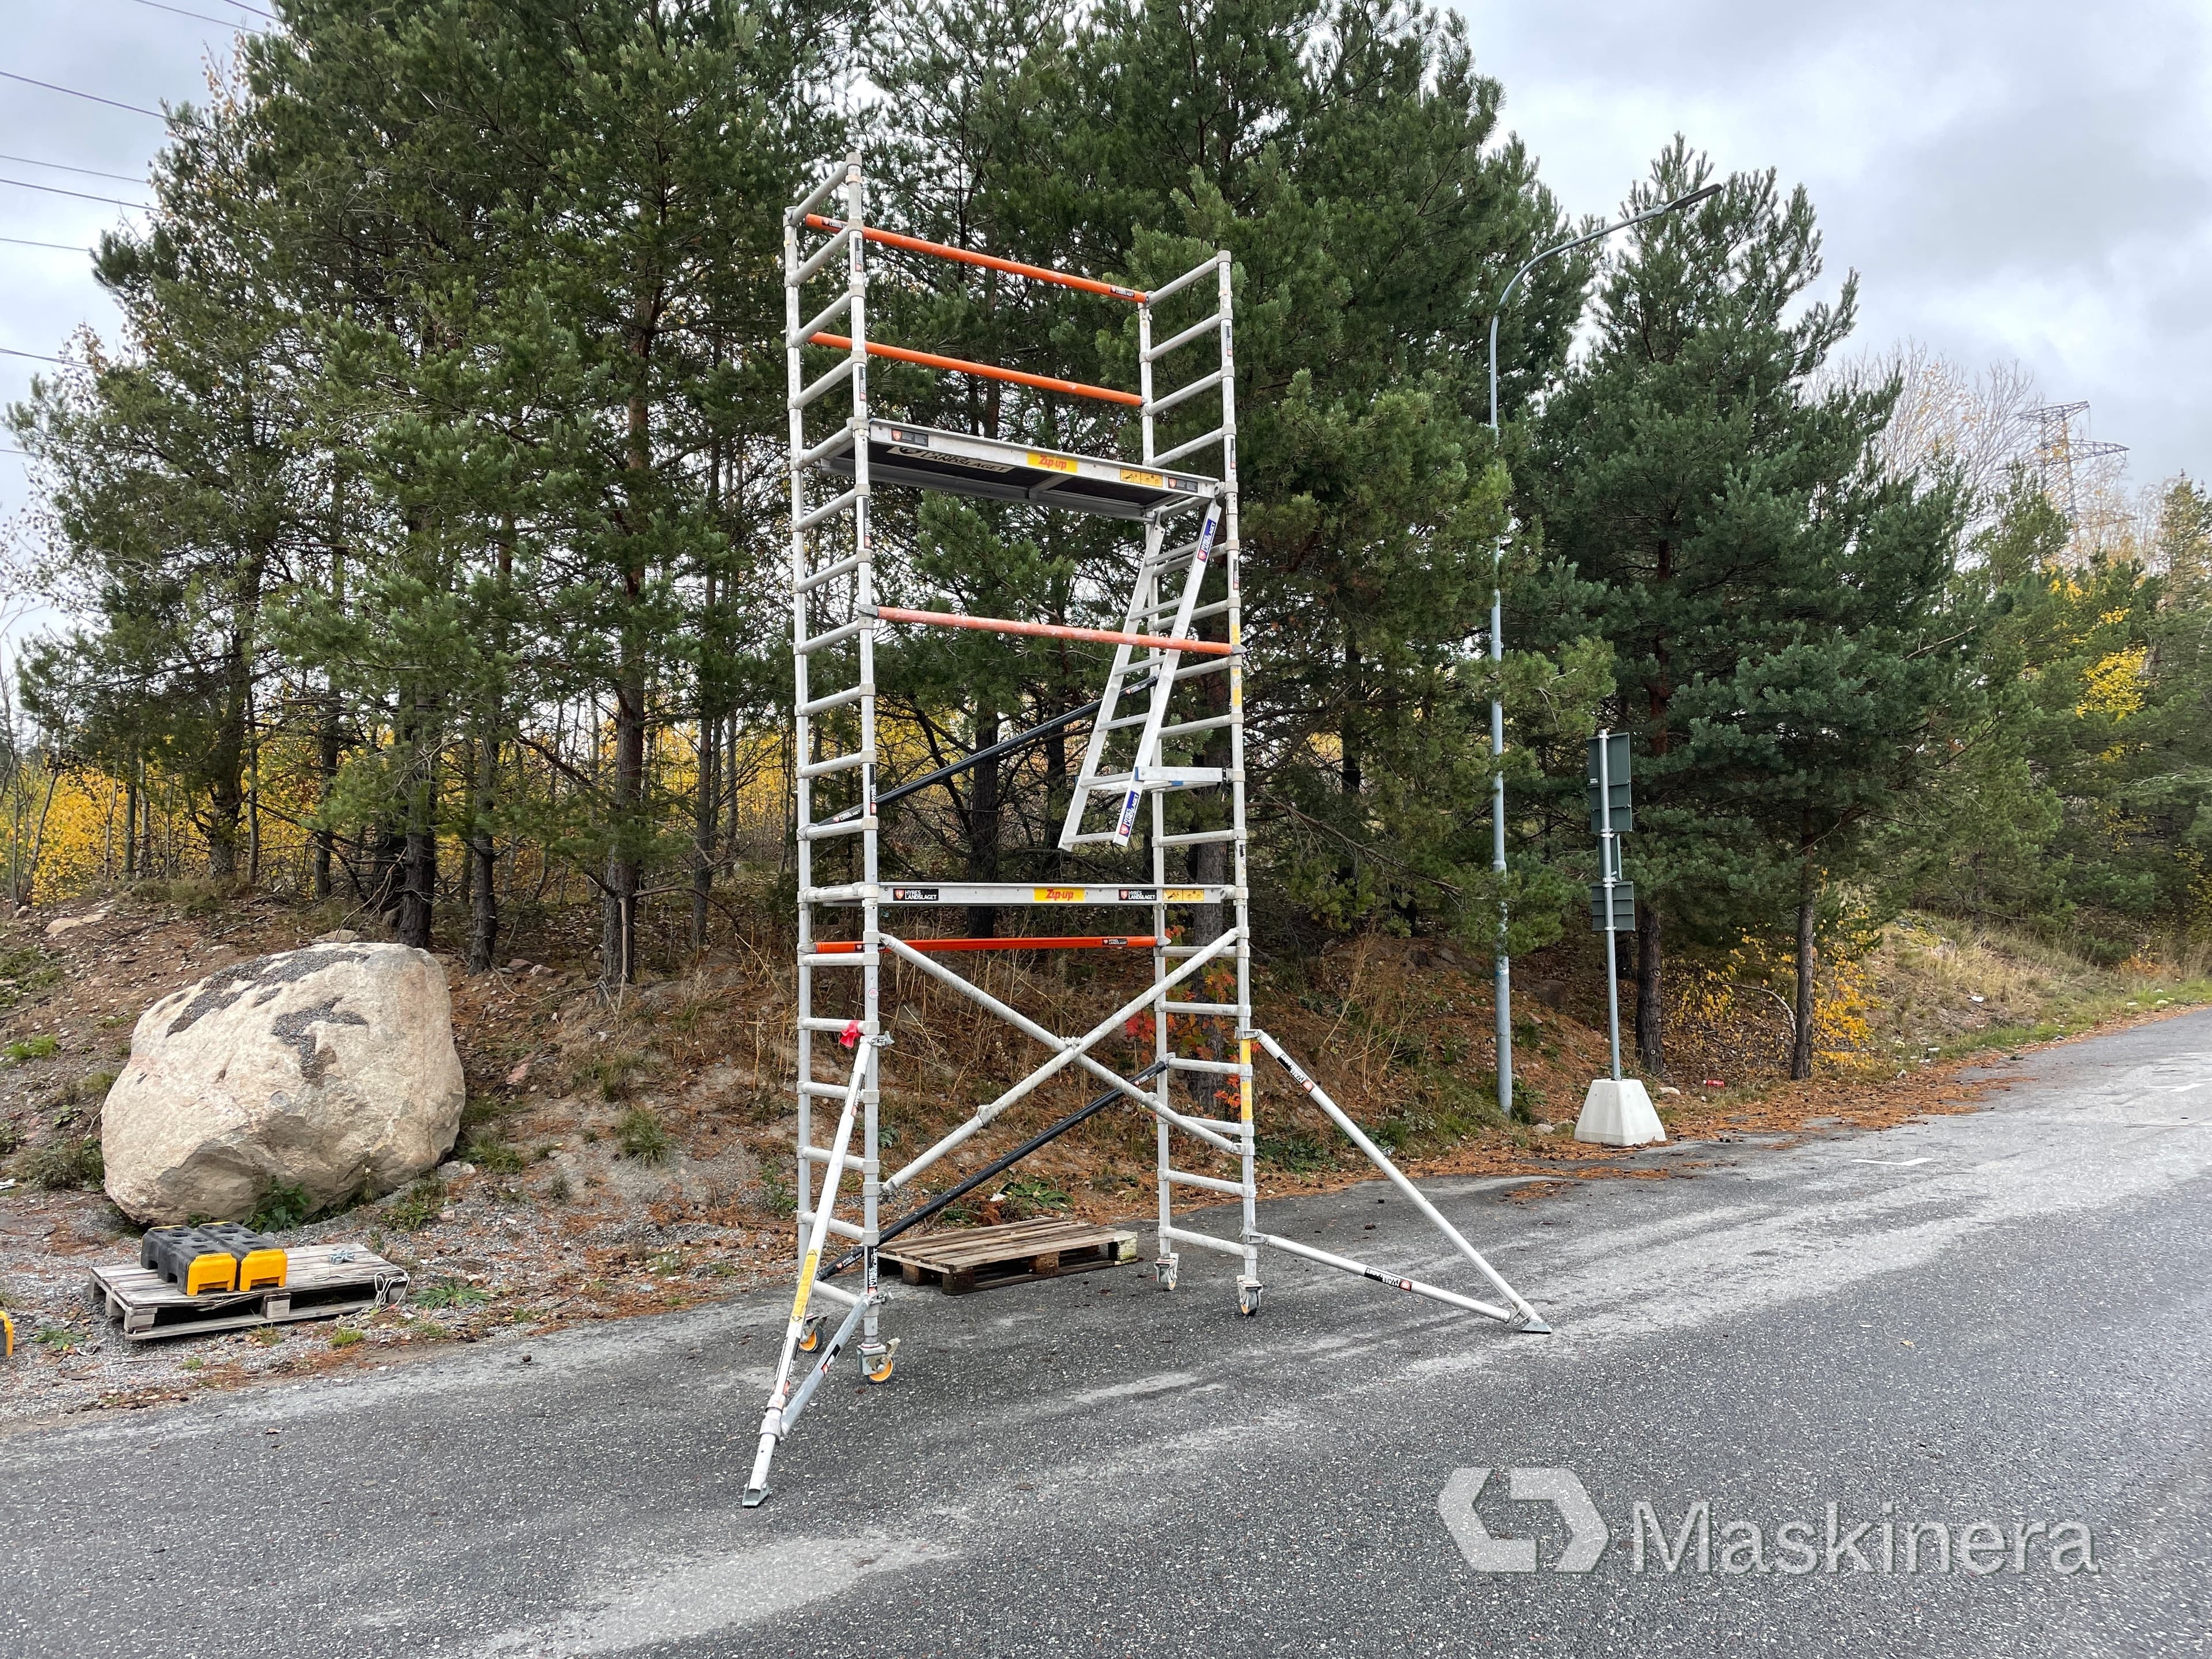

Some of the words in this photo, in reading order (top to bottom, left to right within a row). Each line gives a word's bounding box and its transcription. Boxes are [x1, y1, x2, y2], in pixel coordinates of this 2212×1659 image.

[1046, 889, 1074, 900] Zip-up
[1281, 1054, 1306, 1081] LANDSLAGET
[1366, 1268, 1400, 1282] LANDSLAGET
[1382, 1278, 1399, 1287] HYRES
